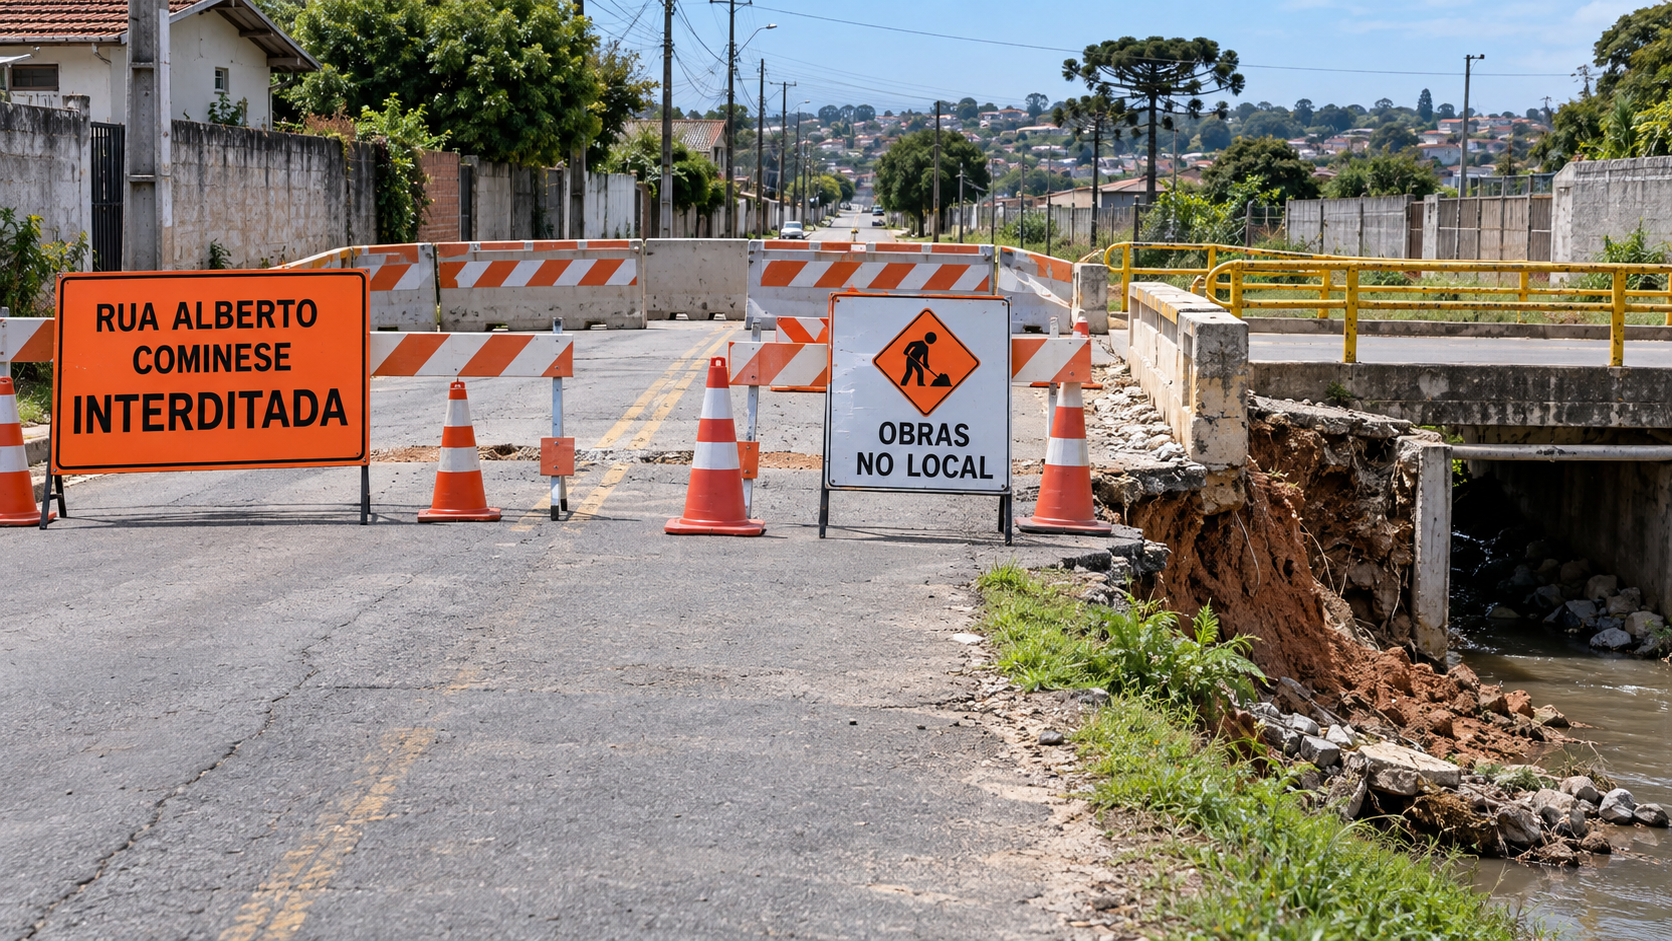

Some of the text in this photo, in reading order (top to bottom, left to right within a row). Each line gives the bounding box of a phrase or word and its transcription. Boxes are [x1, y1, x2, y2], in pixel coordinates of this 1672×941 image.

[97, 299, 317, 332] RUA ALBERTO
[133, 343, 291, 374] COMINESE
[74, 388, 348, 434] INTERDITADA
[879, 422, 969, 447] OBRAS
[857, 452, 993, 480] NO LOCAL
